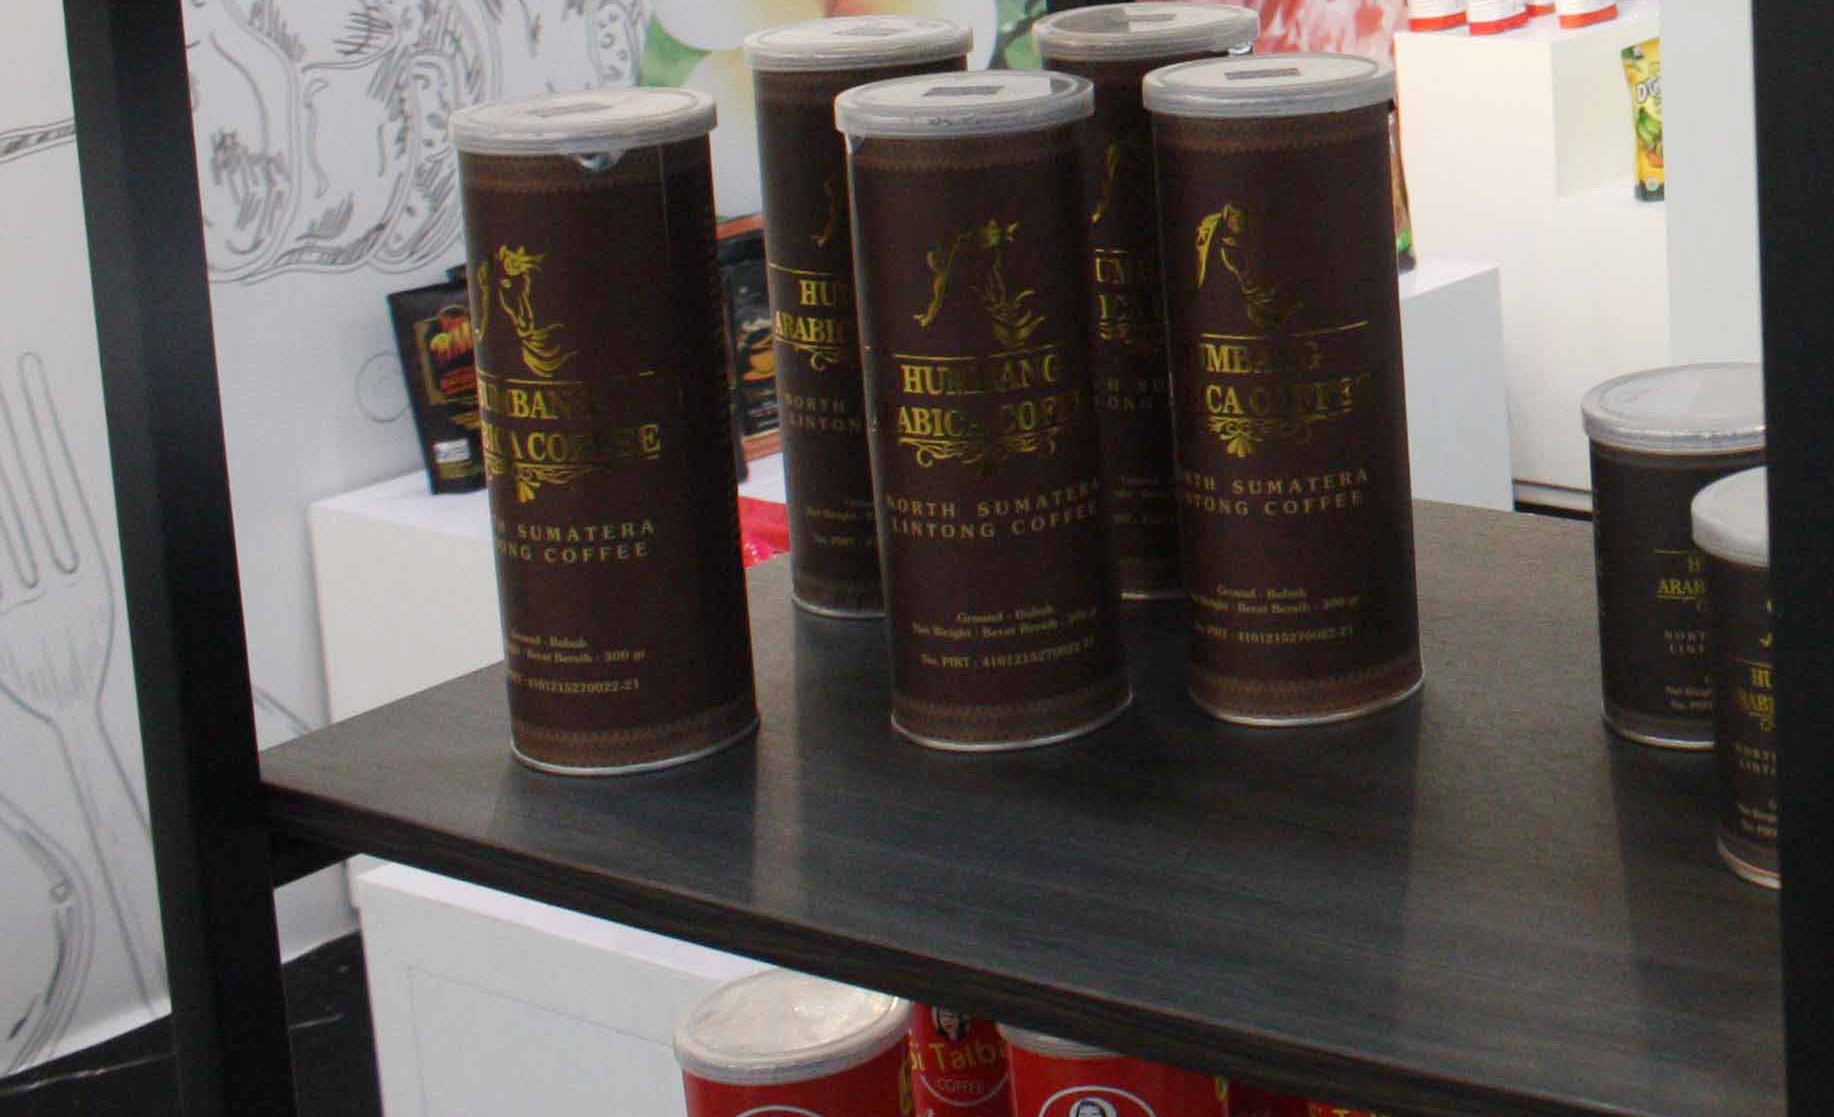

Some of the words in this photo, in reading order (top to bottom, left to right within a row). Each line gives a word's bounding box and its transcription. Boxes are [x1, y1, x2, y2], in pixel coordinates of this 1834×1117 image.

[1232, 467, 1369, 496] SUMATERA
[886, 493, 955, 518] NORTH
[1264, 490, 1361, 516] COFFEE
[517, 517, 655, 542] SUMATERA
[890, 517, 996, 540] LINTONG
[543, 540, 649, 563] COFFEE
